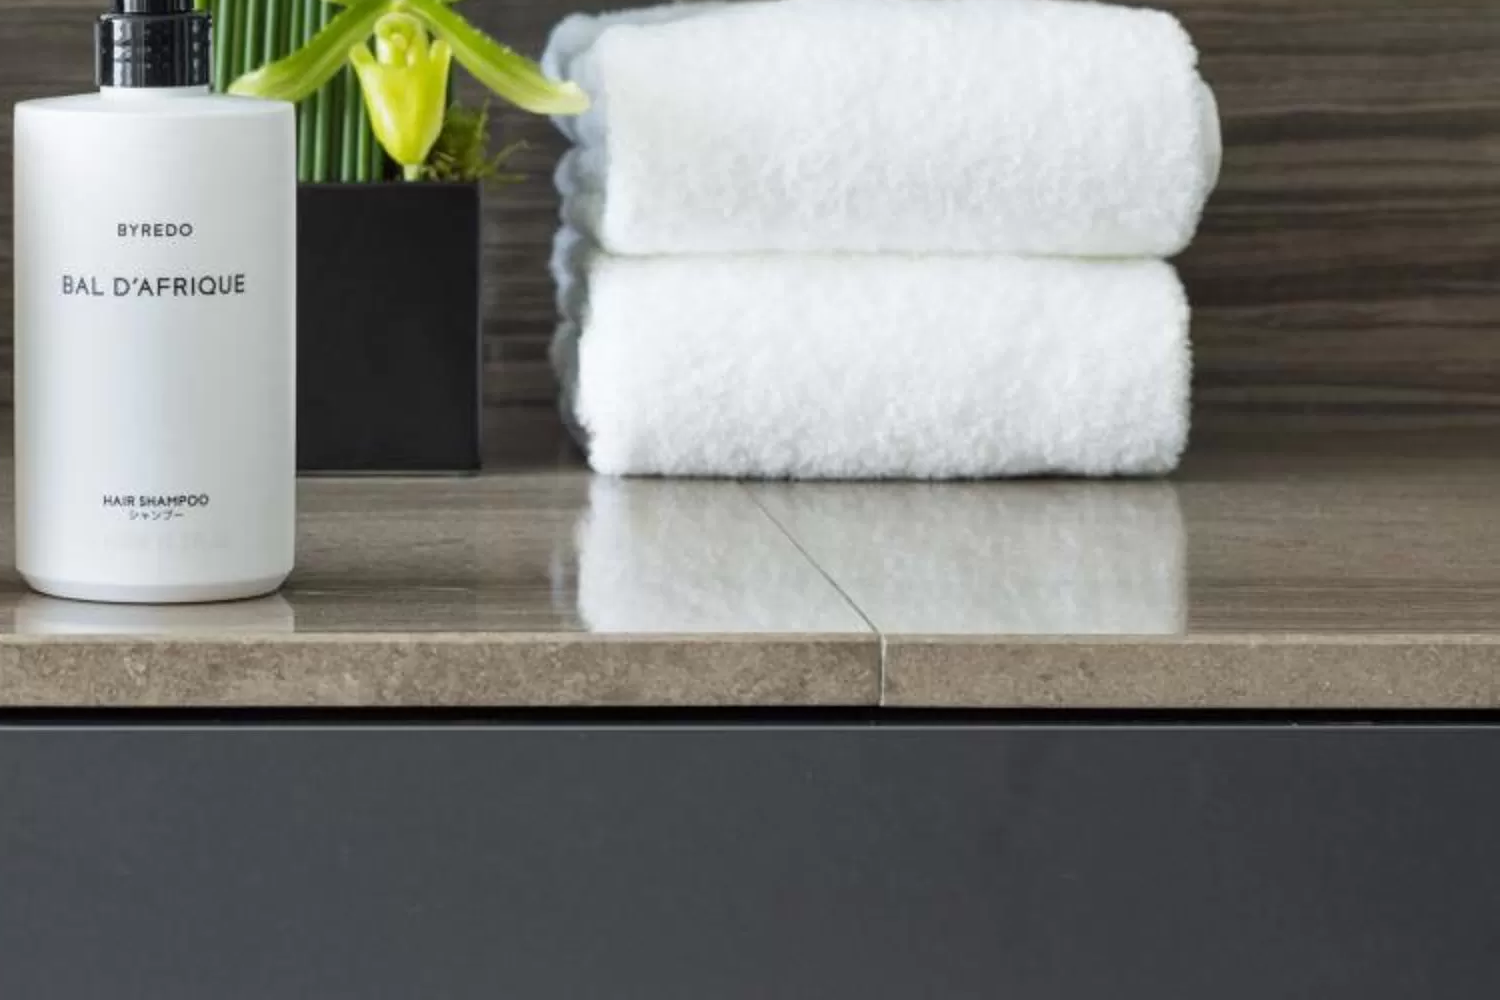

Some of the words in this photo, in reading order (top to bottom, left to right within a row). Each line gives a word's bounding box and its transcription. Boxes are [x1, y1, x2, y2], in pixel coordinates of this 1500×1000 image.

[117, 223, 193, 237] BYREDO
[62, 275, 105, 296] BAL
[113, 274, 246, 297] D'AFRIQUE
[103, 495, 136, 507] HAIR
[139, 494, 210, 507] SHAMPOO
